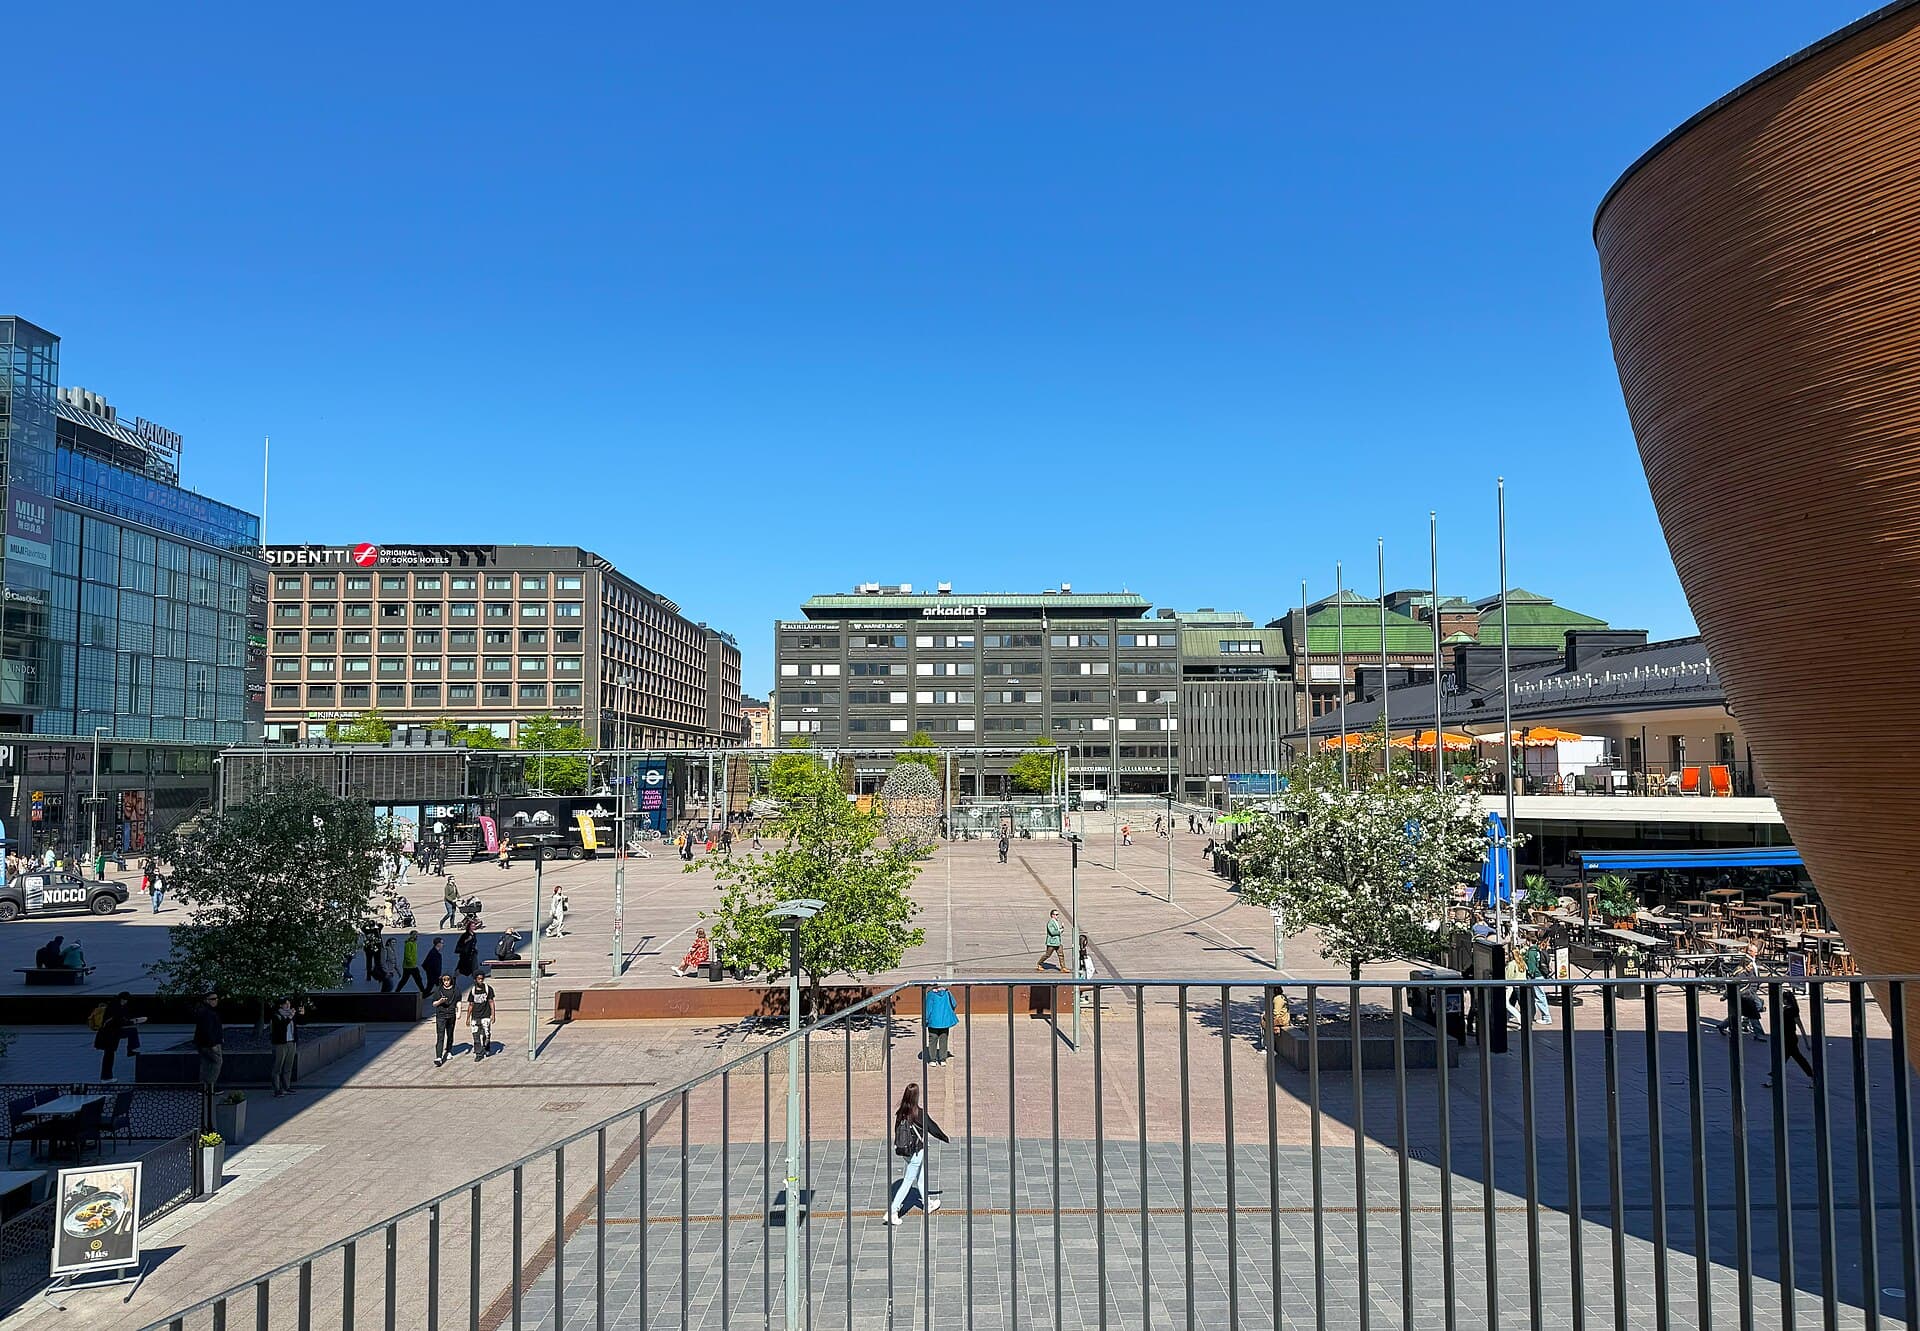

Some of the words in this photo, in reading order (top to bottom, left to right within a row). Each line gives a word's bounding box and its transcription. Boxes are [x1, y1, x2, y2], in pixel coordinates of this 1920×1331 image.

[136, 416, 183, 454] KAMPPI
[15, 499, 45, 525] MUJI
[977, 604, 987, 616] 6
[44, 796, 62, 806] ICKS
[43, 888, 87, 904] NOCCO
